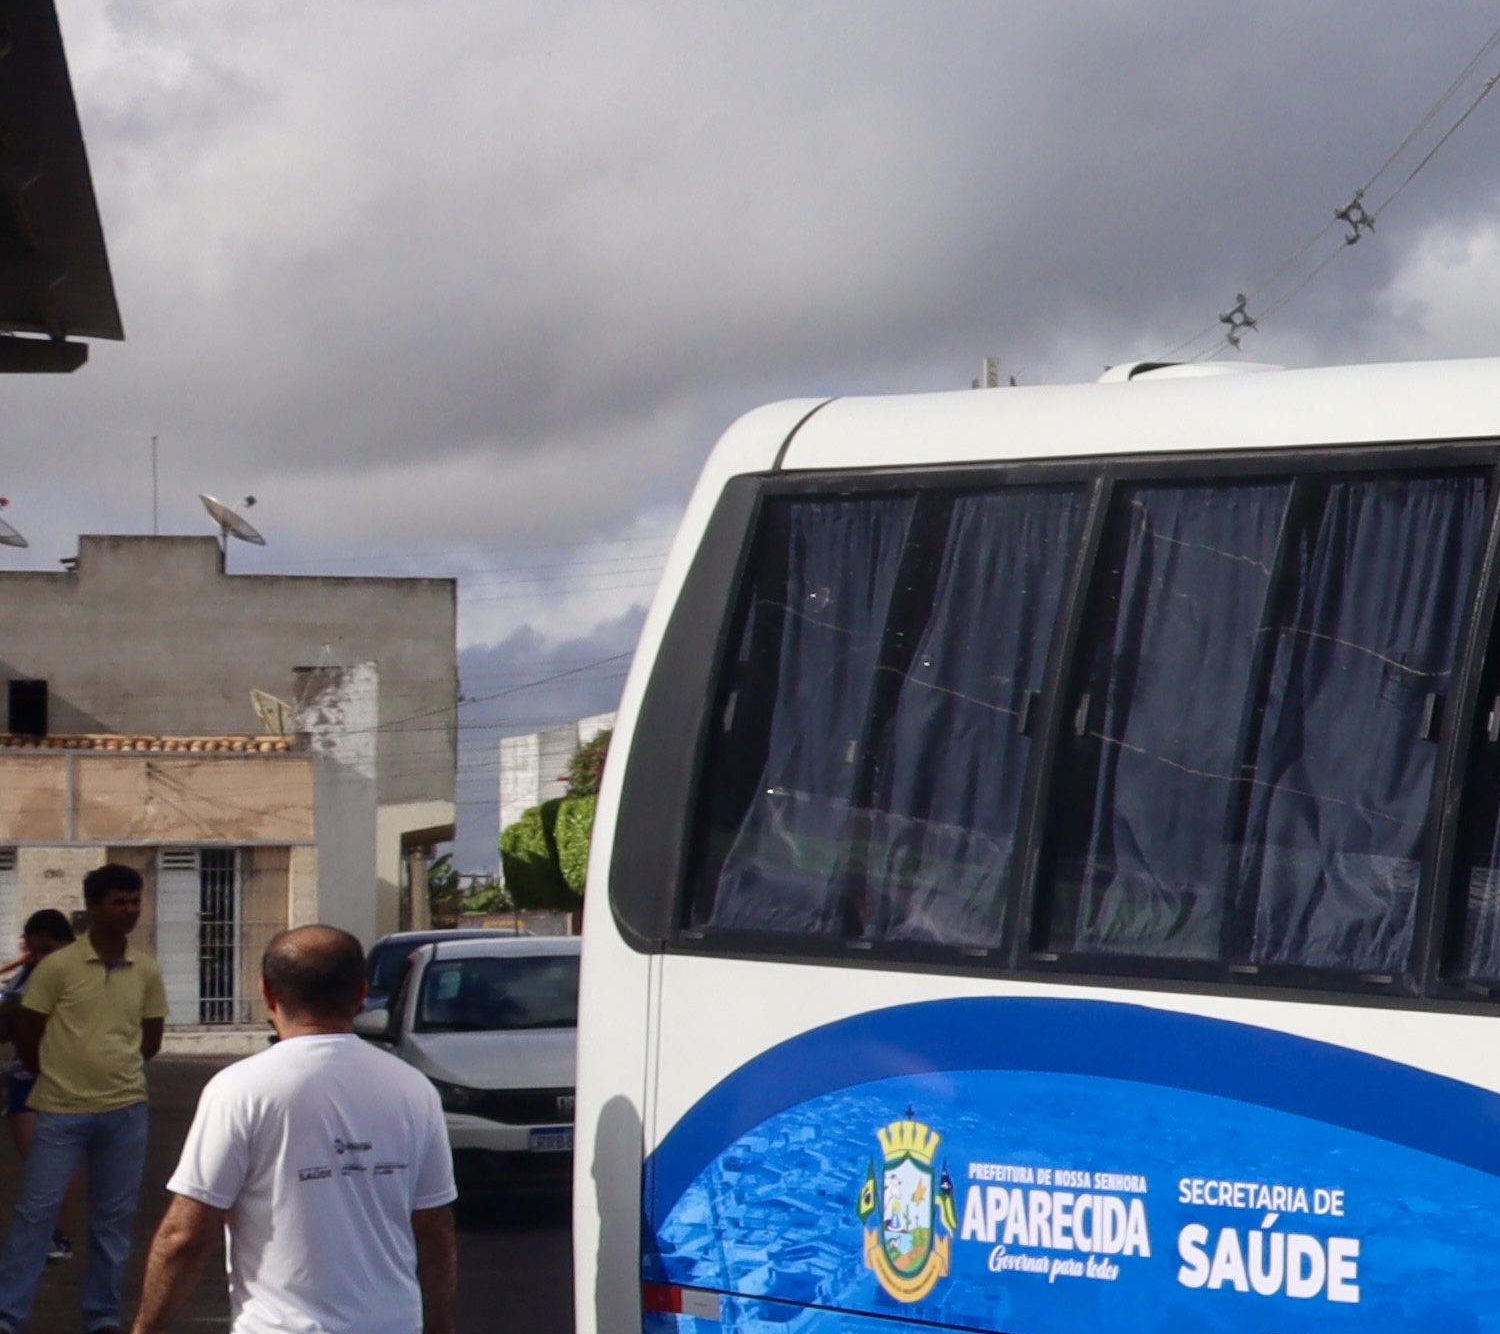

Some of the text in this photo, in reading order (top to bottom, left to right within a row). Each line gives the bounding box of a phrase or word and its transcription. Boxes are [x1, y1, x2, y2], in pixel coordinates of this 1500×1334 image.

[968, 1162, 1148, 1194] PREFEITURA DE NOSSA SENHORA
[1178, 1178, 1345, 1217] SECRETARIA DE
[960, 1184, 1151, 1258] APARECIDA
[988, 1244, 1120, 1284] Governar para todos
[1177, 1212, 1360, 1304] SAÚDE
